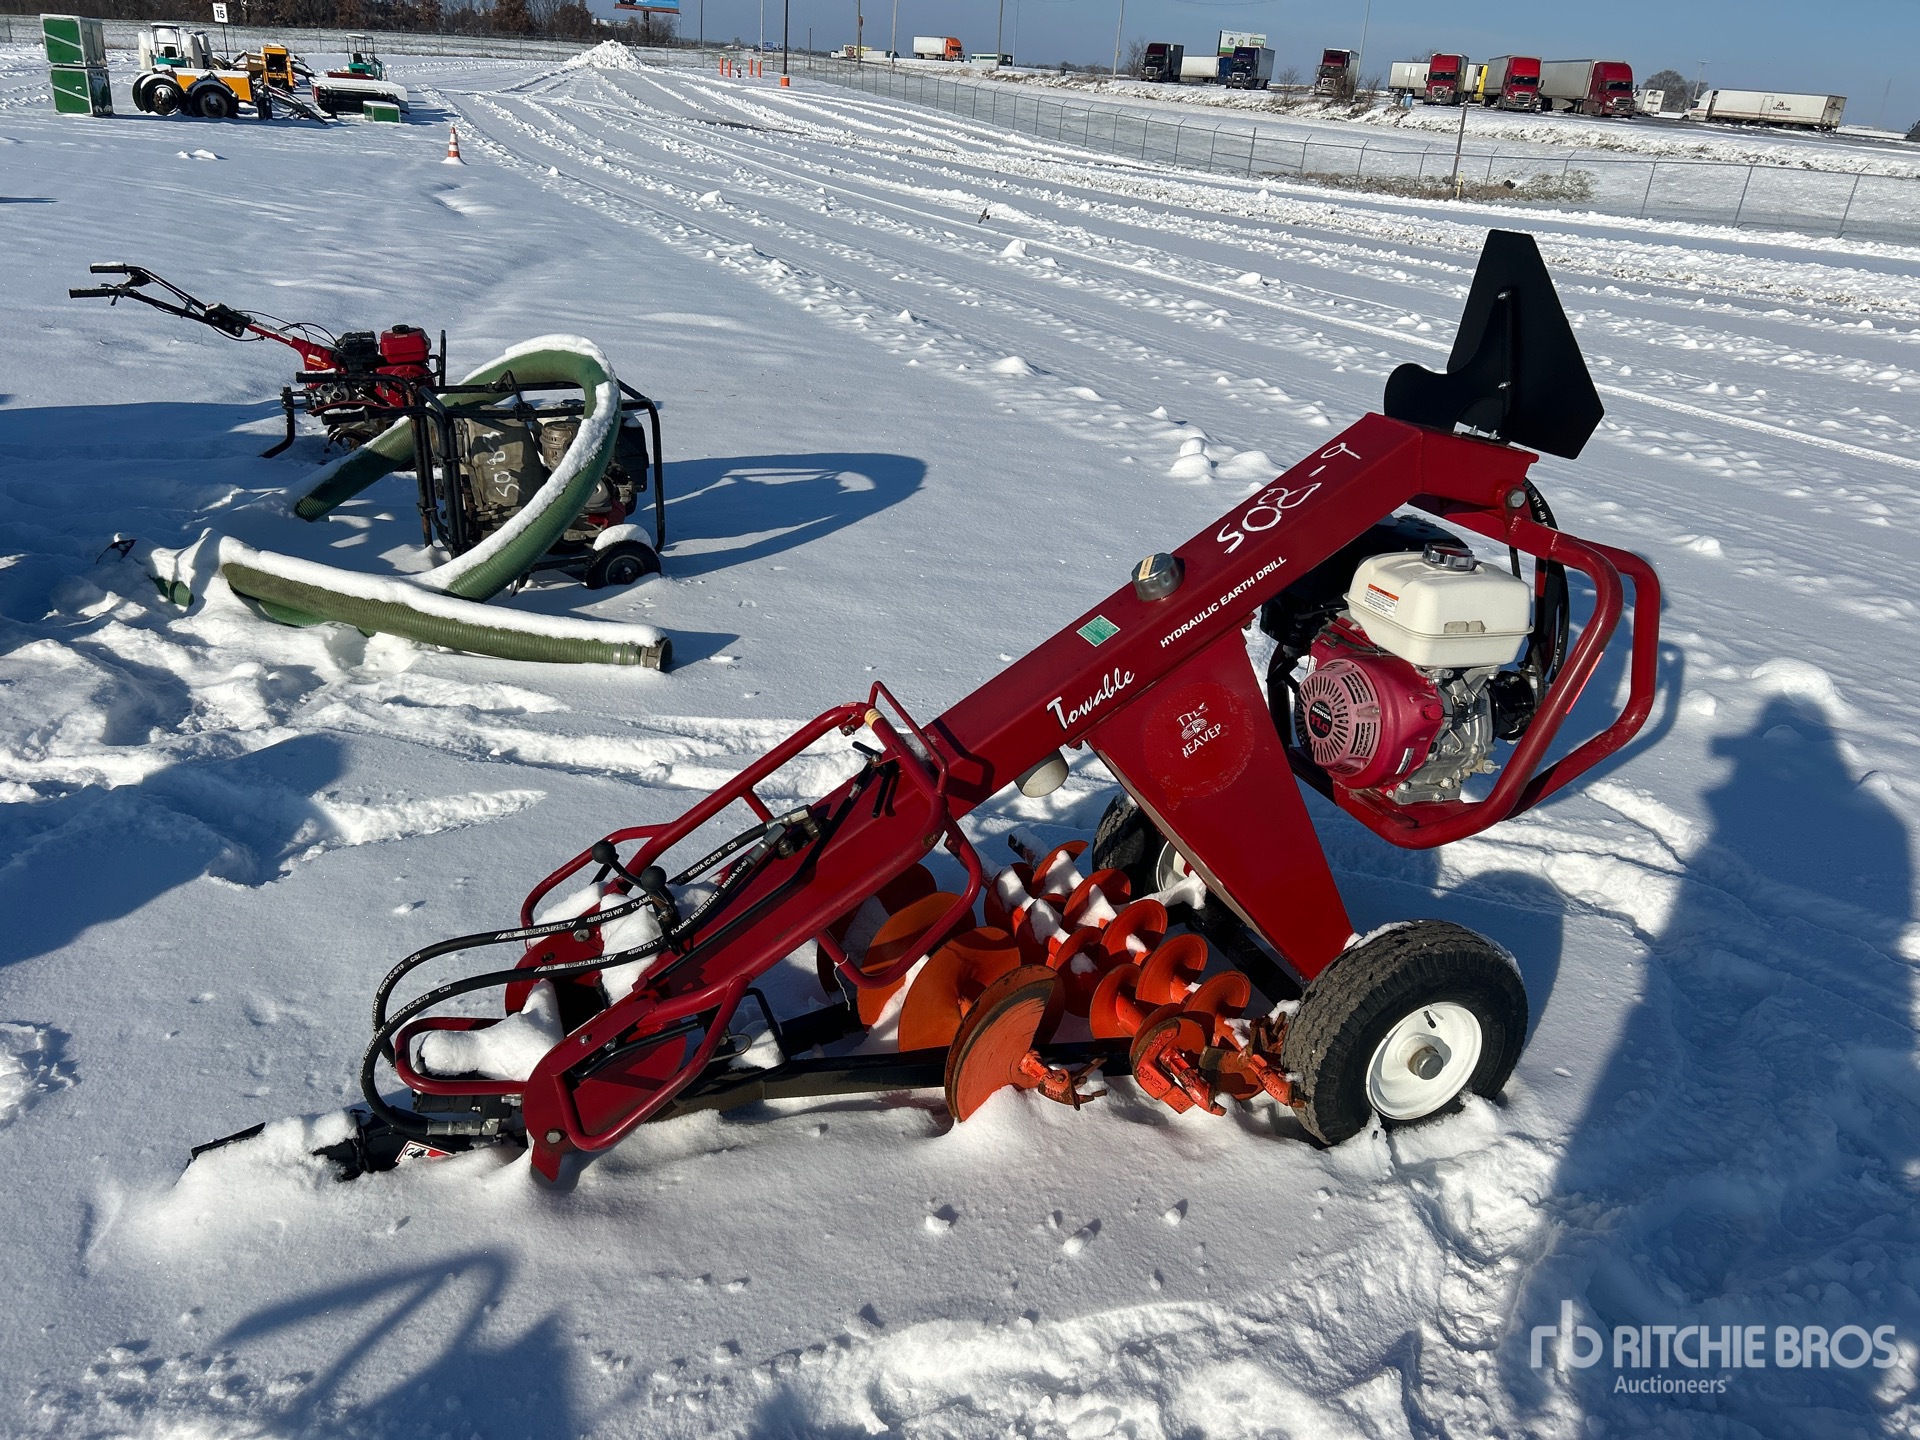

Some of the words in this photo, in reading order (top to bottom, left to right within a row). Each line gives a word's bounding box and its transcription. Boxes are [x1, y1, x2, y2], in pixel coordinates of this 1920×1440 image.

[216, 10, 225, 18] 15
[1160, 602, 1220, 648] HYDRAULIC
[1220, 576, 1256, 606] EARTH
[1255, 556, 1287, 580] DRILL
[1046, 667, 1135, 730] Towable
[1312, 706, 1331, 721] HONDA
[1310, 714, 1329, 734] 11.0
[687, 863, 705, 877] MSHA
[727, 841, 738, 851] CSI
[670, 919, 691, 936] FLAME
[690, 891, 720, 920] RESISTANT
[721, 873, 737, 889] MSHA
[586, 915, 601, 924] 4800
[602, 911, 613, 920] PSI
[613, 907, 624, 916] WP
[410, 954, 421, 962] CSI
[626, 946, 642, 956] 4800
[389, 1008, 407, 1024] MSHA
[438, 985, 451, 993] CSI
